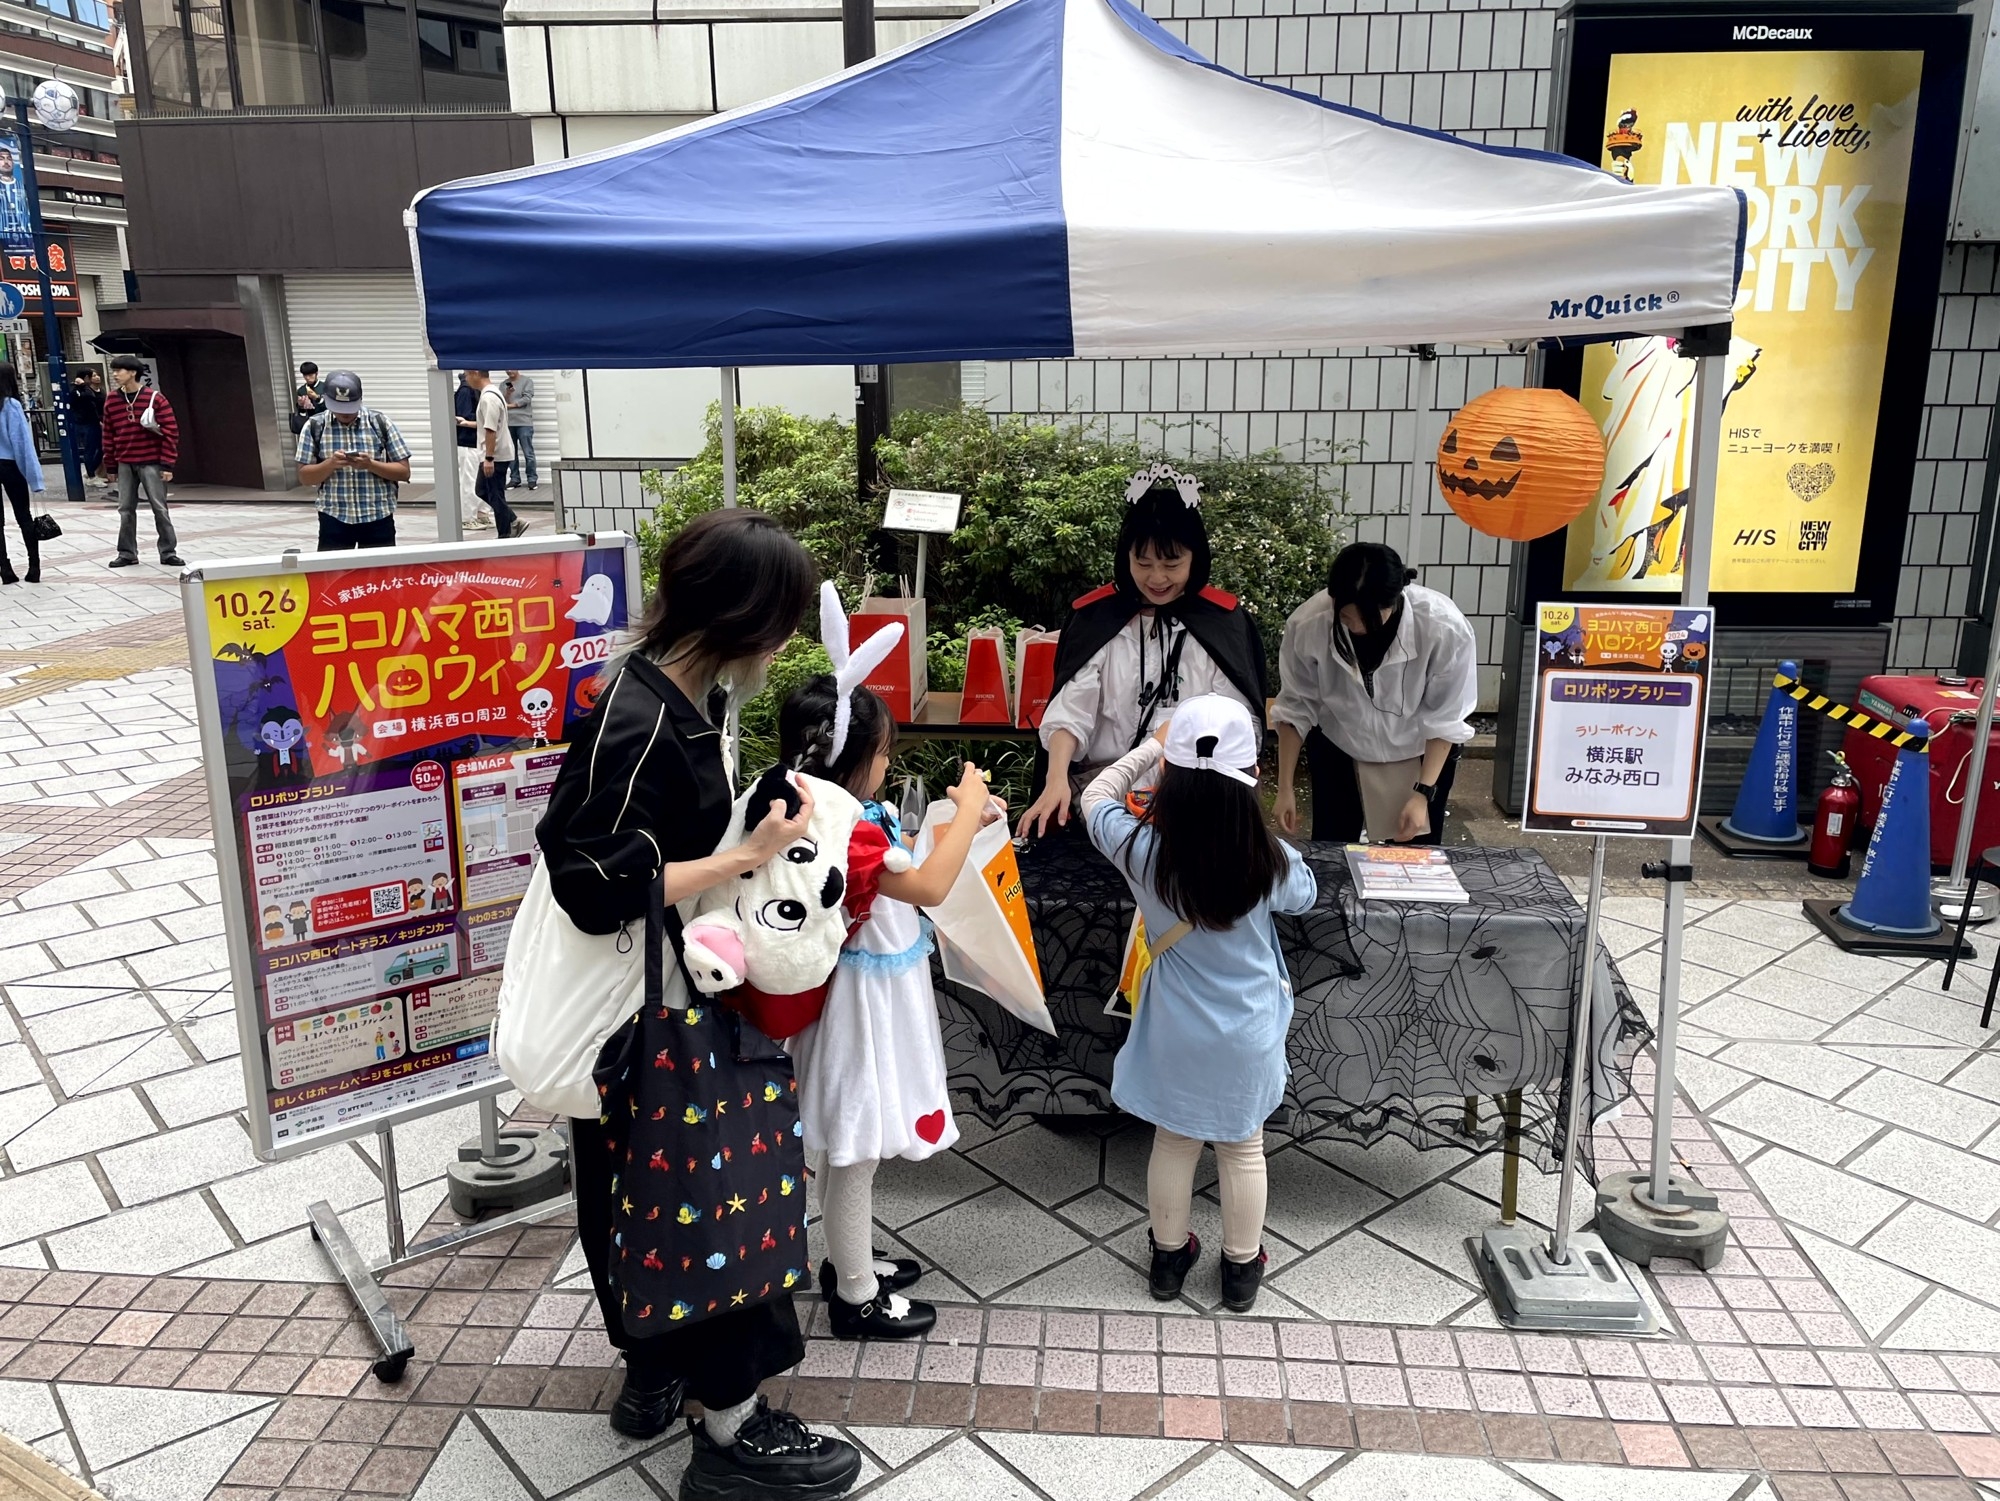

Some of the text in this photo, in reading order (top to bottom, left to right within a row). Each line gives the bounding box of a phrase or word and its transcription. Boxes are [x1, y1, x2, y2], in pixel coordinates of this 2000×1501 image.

[1733, 25, 1812, 41] MCDecaux
[1736, 94, 1855, 122] with Love
[1778, 120, 1872, 154] Liberty,
[1661, 121, 1834, 186] NEW
[1549, 291, 1663, 320] MrQuick
[1728, 427, 1762, 439] HISで
[1800, 520, 1832, 531] NEW
[1733, 529, 1777, 546] HIS
[1799, 530, 1829, 541] YORK
[1798, 540, 1828, 551] CITY
[214, 588, 297, 619] 10.26
[242, 614, 276, 632] sat.
[1543, 610, 1570, 620] 10.26
[311, 595, 556, 655] ヨコハマ西口
[1587, 619, 1664, 634] ヨコハマ西口
[1585, 633, 1663, 652] ハロウィン
[314, 643, 556, 719] ハロウィン
[1564, 683, 1683, 701] ロリポップラリー
[377, 705, 507, 735] 会場 横浜西口周辺
[1575, 724, 1658, 739] ラリーポイント
[1586, 745, 1644, 765] 横浜駅
[455, 756, 506, 775] 会場MAP
[1564, 766, 1660, 787] みなみ西口
[250, 781, 347, 808] ロリポップラリー
[447, 993, 466, 1005] POP
[467, 987, 489, 999] STEP
[273, 1050, 451, 1108] 詳しくはホームページをご覧ください
